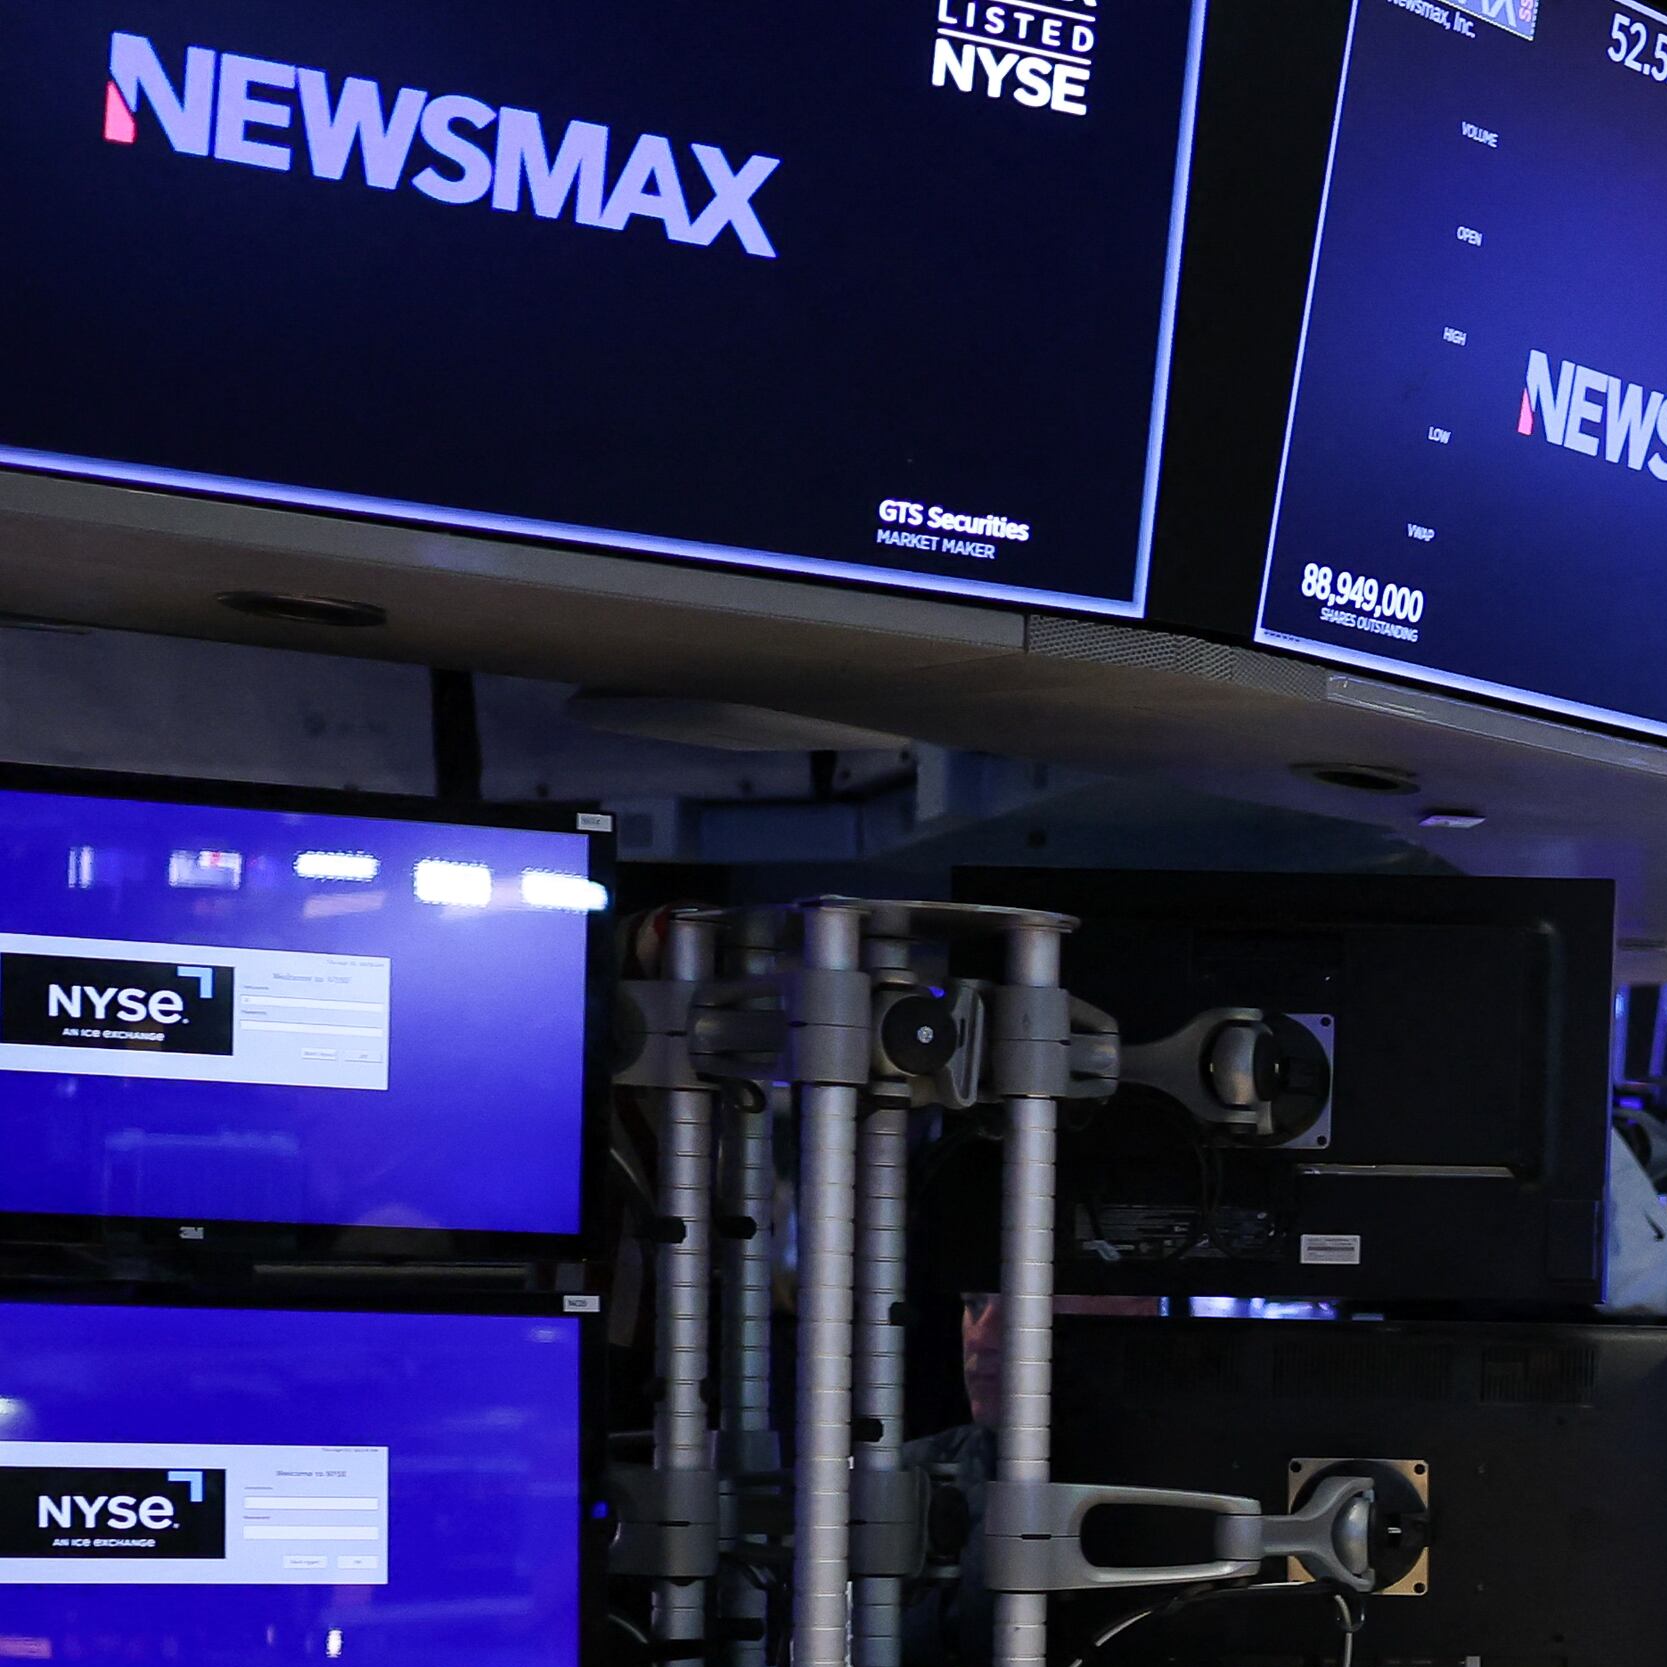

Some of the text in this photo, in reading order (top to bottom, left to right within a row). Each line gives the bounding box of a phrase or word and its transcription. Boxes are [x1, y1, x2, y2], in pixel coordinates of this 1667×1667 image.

[938, 0, 1094, 52] LISTED
[1388, 0, 1476, 38] ewsmax, Inc.
[932, 38, 1091, 116] NYSE
[104, 32, 780, 258] NEWSMAX
[1461, 121, 1499, 148] VOLUME
[1456, 226, 1482, 247] OPEN
[1443, 327, 1467, 346] HIGH
[1428, 426, 1451, 444] LOW
[878, 499, 1031, 542] GTS Securities
[876, 528, 995, 559] MARKET MAKER
[1301, 562, 1424, 623] 88,949,000
[1320, 607, 1419, 643] SHARES OUTSTANDING
